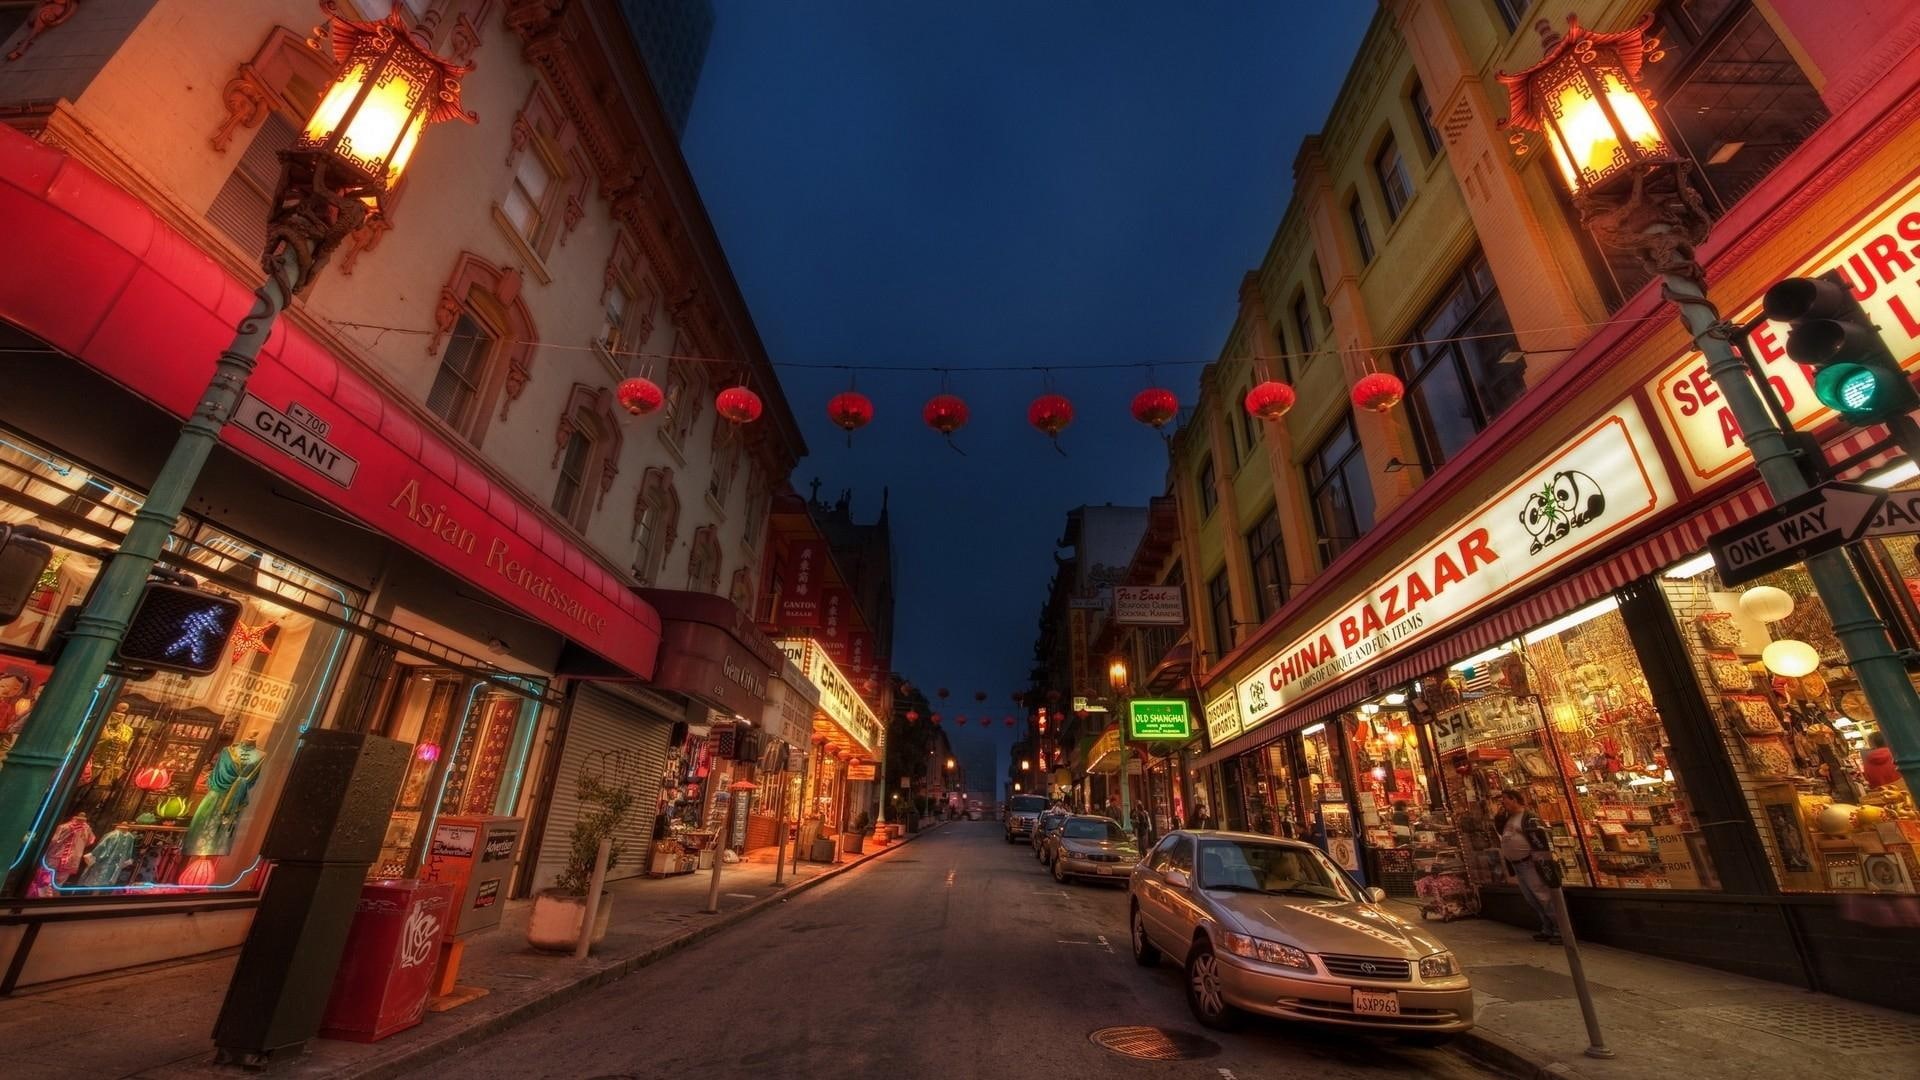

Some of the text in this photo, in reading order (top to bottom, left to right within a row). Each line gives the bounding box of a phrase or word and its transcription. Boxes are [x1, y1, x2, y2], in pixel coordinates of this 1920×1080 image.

[305, 413, 327, 435] 700
[255, 410, 341, 470] GRANT
[1729, 506, 1829, 567] ONE WAY
[389, 478, 608, 636] Asian Renaissance
[1139, 588, 1167, 601] East
[1269, 527, 1500, 692] CHINA BAZAAR
[1315, 665, 1327, 684] OF
[1325, 650, 1354, 678] UNIQUE
[1355, 640, 1372, 661] AND
[1371, 630, 1391, 653] FUN
[1391, 611, 1424, 641] ITEMS
[820, 663, 856, 714] CANTON
[1135, 714, 1184, 723] OLD SHANGHAI
[1208, 695, 1235, 724] DISCOUNT
[1211, 714, 1237, 740] IMPORTS
[1656, 834, 1682, 845] FRONT
[1663, 861, 1692, 872] FRONT
[1356, 996, 1397, 1013] 4SXP963
